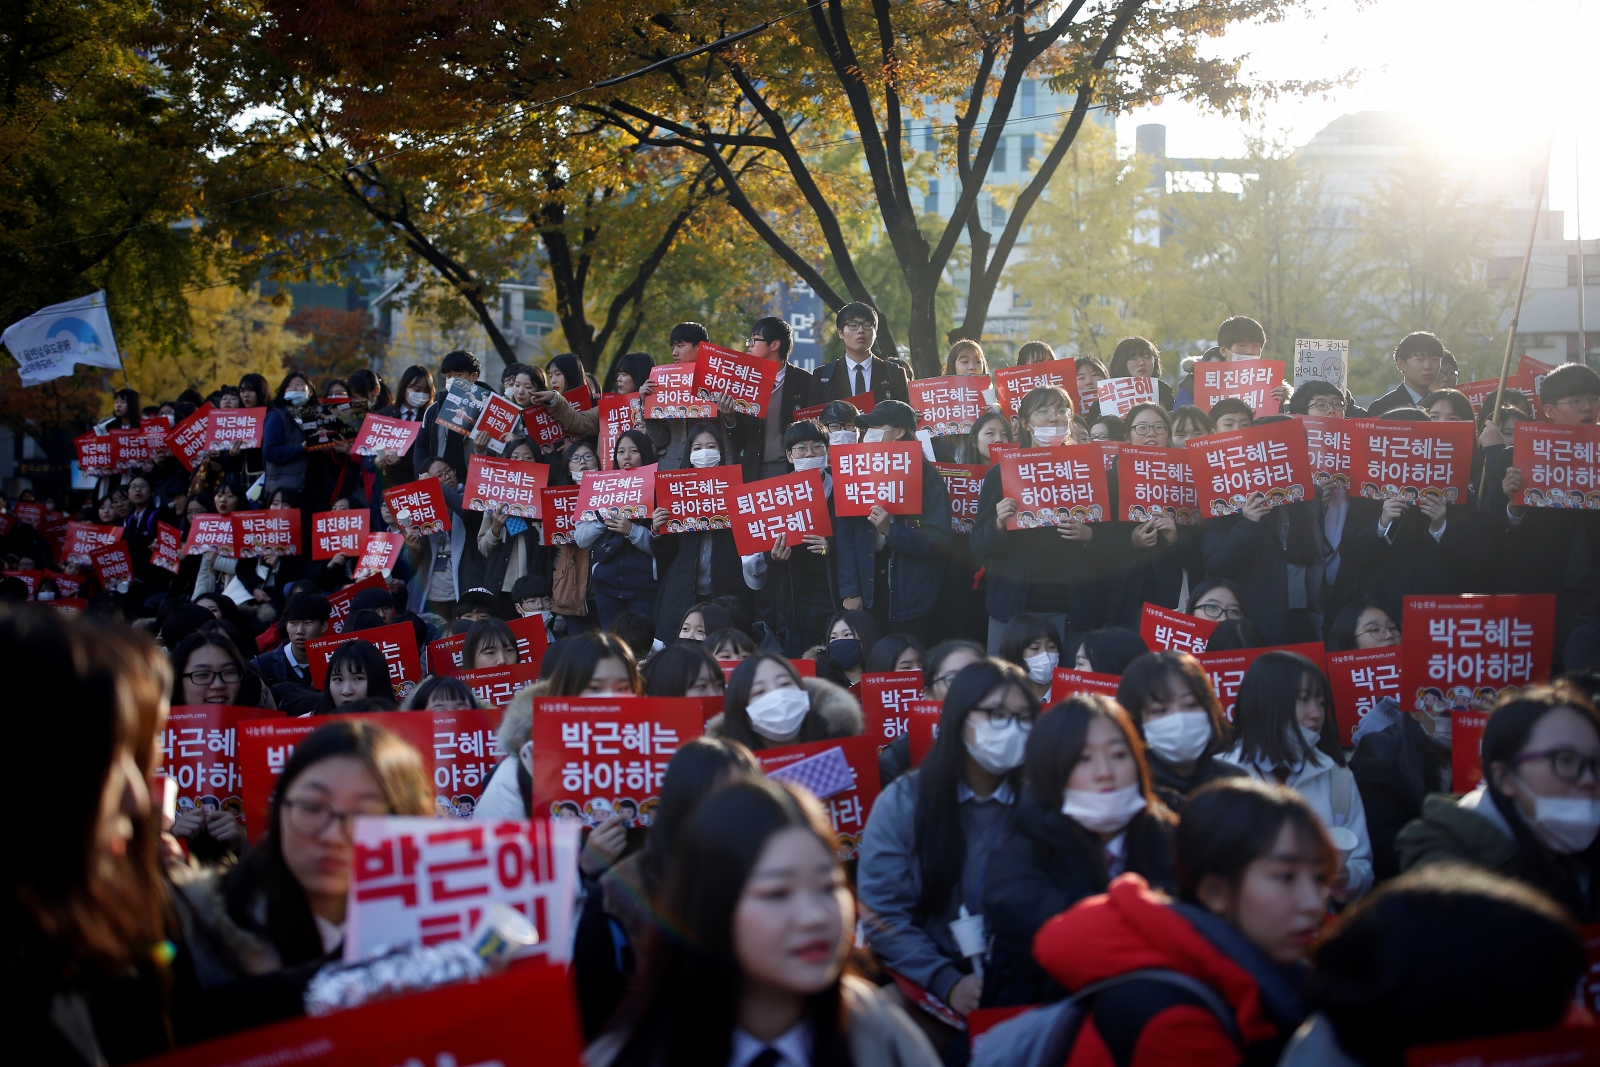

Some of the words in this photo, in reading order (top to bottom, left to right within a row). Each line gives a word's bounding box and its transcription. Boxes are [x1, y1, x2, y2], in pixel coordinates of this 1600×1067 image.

[1298, 350, 1314, 363] 길은
[708, 356, 762, 384] 박근혜는
[1204, 367, 1273, 390] 퇴진하라
[704, 373, 759, 401] 하야하라
[1007, 373, 1063, 394] 박근혜는
[1098, 376, 1154, 403] 박근혜
[921, 387, 979, 405] 박근혜는
[216, 416, 257, 428] 박근혜는
[490, 404, 515, 424] 박근혜
[923, 404, 981, 422] 하야하라
[214, 428, 256, 440] 하야하라
[371, 422, 412, 438] 박근혜는
[183, 431, 207, 457] 하야
[365, 435, 406, 449] 하야하라
[1369, 435, 1454, 459] 박근혜는
[1533, 439, 1600, 463] 박근혜
[839, 451, 912, 477] 퇴진하라
[1206, 440, 1288, 470] 박근혜는
[480, 466, 536, 487] 박근혜는
[1018, 460, 1090, 483] 박근혜는
[1211, 462, 1294, 494] 하야하라
[1367, 460, 1454, 485] 하야하라
[1531, 464, 1600, 488] 하야하
[477, 483, 534, 504] 하야하라
[593, 476, 645, 493] 박근혜는
[669, 478, 730, 498] 박근혜는
[844, 480, 904, 505] 박근혜!
[1021, 482, 1094, 507] 하야하라
[390, 491, 432, 511] 박근혜는
[589, 489, 643, 507] 하야하라
[736, 480, 813, 515] 퇴진하라
[199, 520, 233, 532] 박근혜
[242, 518, 290, 531] 박근혜는
[316, 515, 363, 533] 퇴진하라
[747, 508, 815, 541] 박근혜!
[75, 530, 116, 545] 박근혜는
[243, 531, 292, 545] 하야하라
[319, 534, 359, 552] 박근혜!
[366, 541, 393, 554] 박근혜는
[96, 550, 126, 566] 박근혜는
[360, 555, 389, 568] 하야하라
[101, 561, 129, 578] 하야하라
[1429, 617, 1534, 648] 박근혜는
[1427, 651, 1534, 684] 하야하라
[156, 727, 240, 759] 박근혜
[561, 721, 680, 756] 박근혜는
[354, 817, 553, 909] 박근혜
